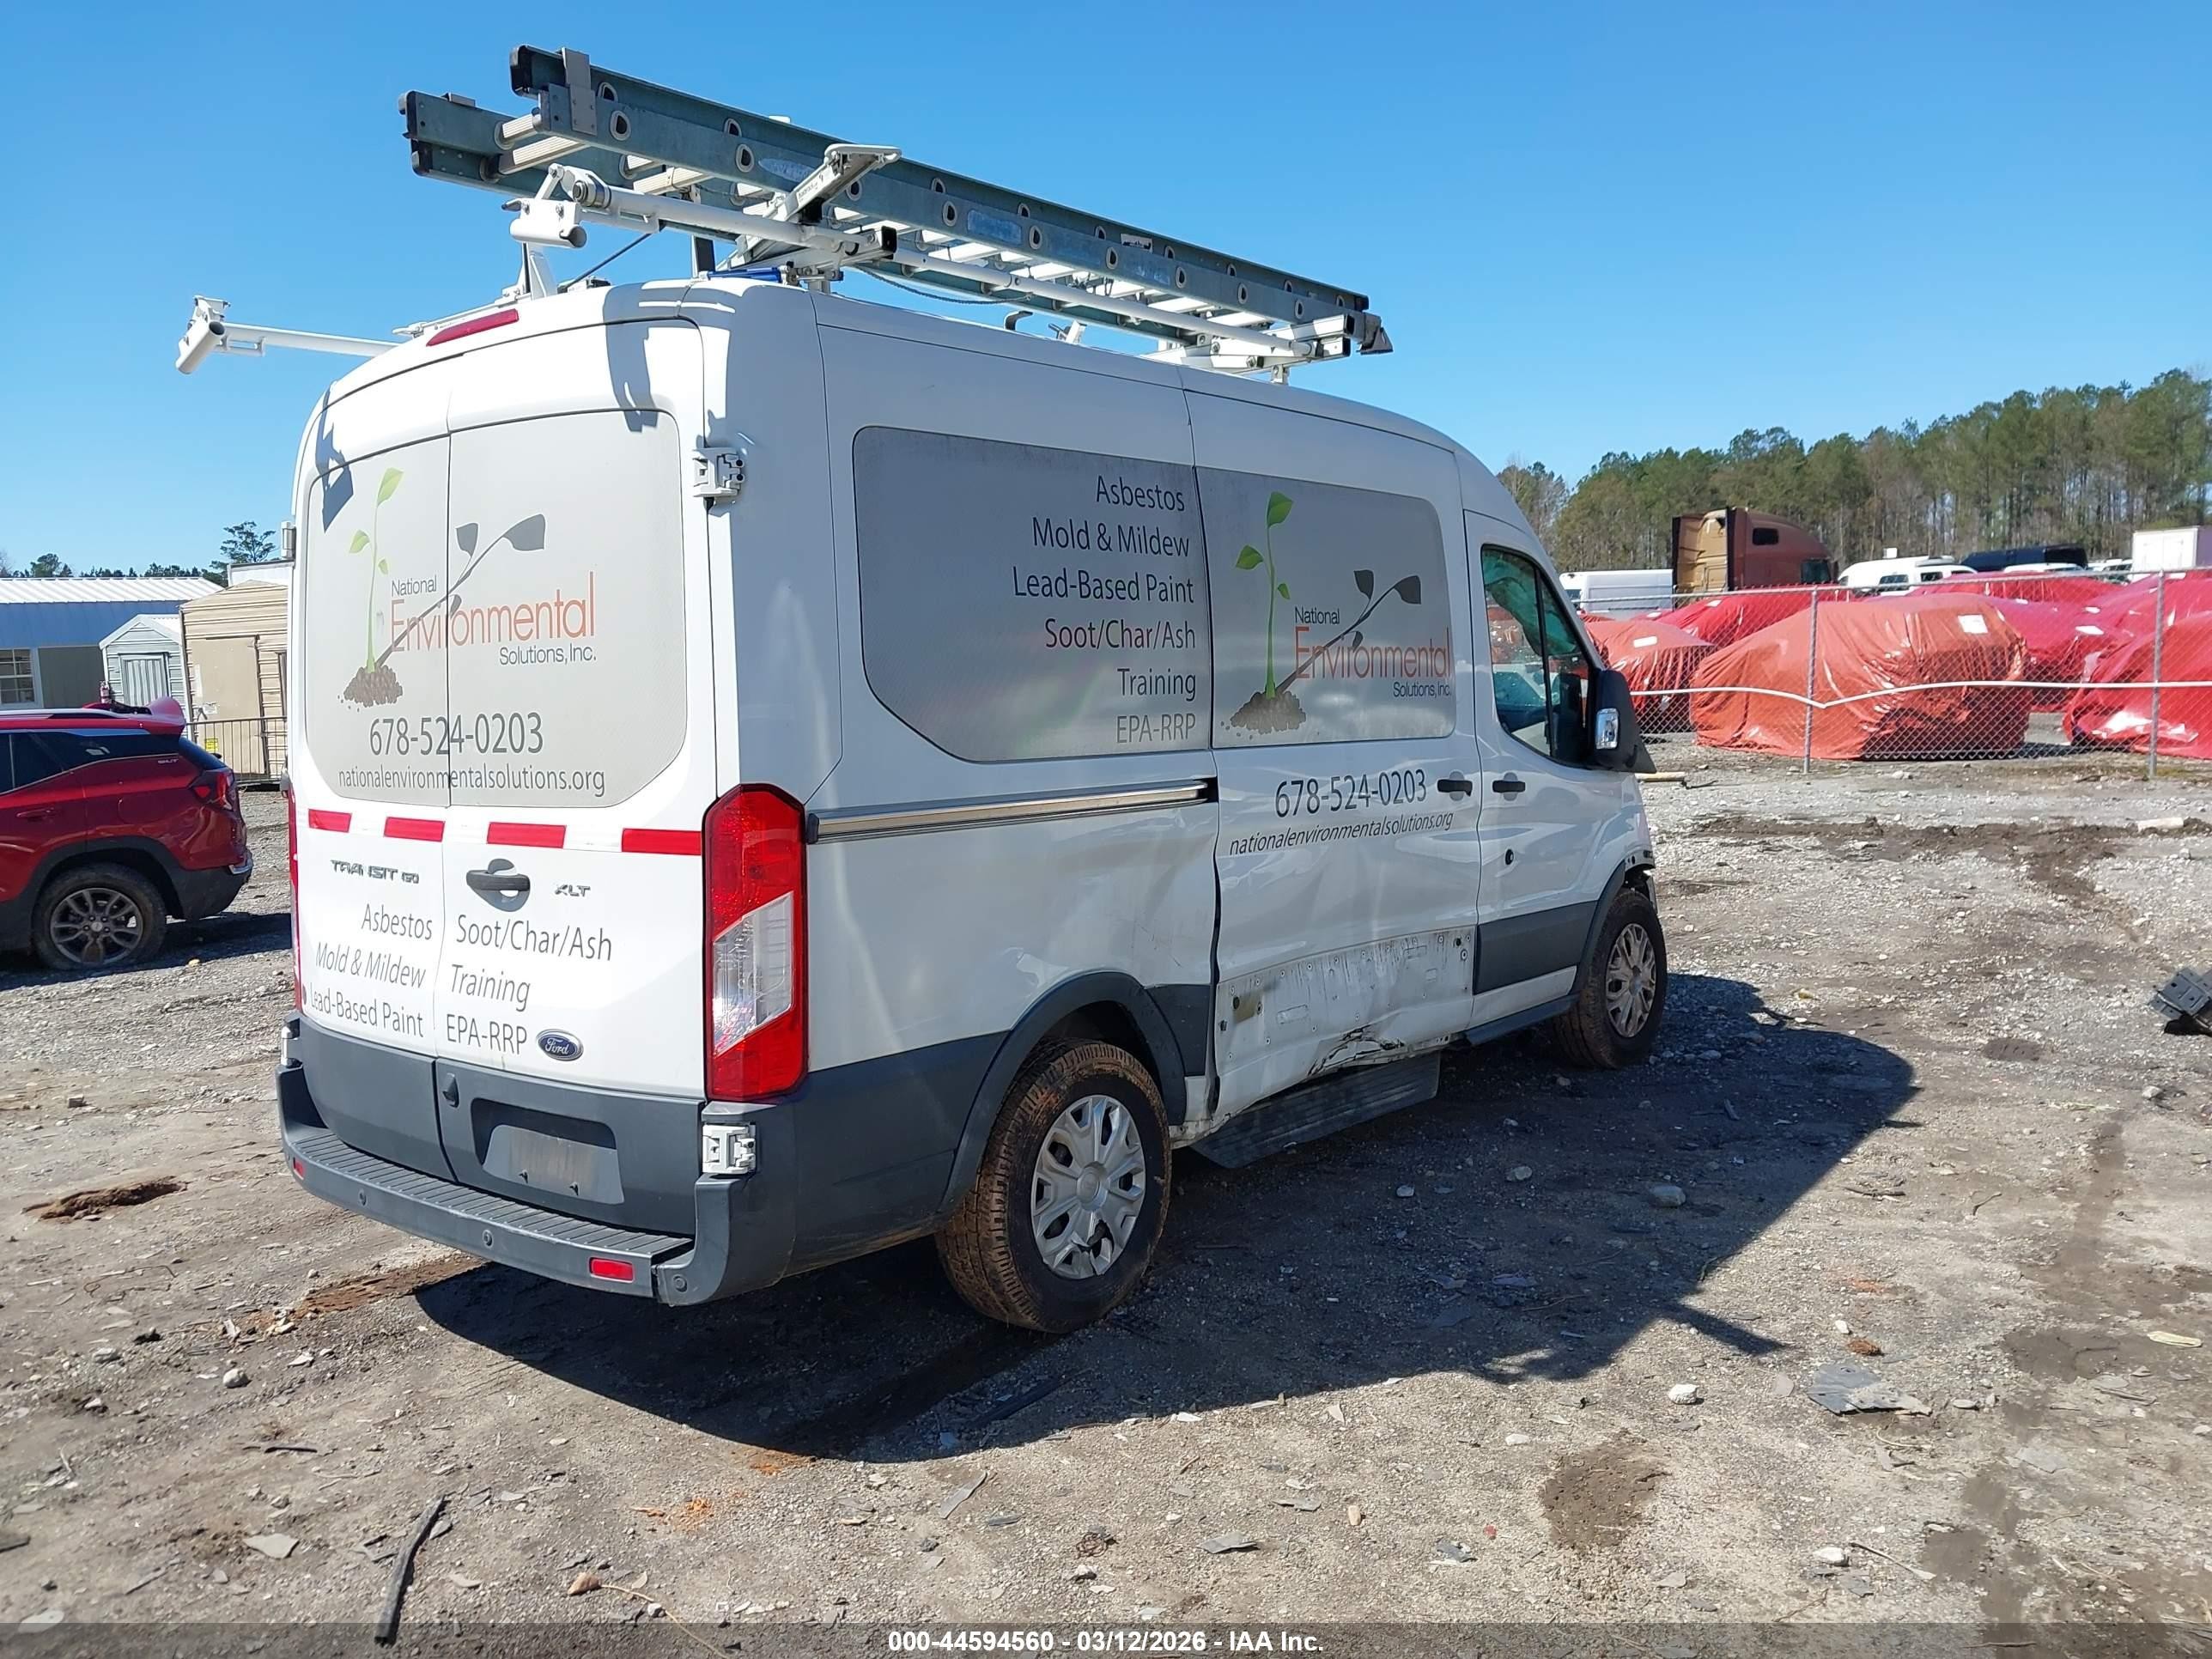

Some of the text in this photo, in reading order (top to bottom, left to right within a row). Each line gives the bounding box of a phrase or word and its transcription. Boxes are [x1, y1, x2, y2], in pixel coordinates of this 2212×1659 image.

[1097, 475, 1185, 512] Asbestos
[1032, 517, 1190, 557] Mold & Mildew
[392, 574, 437, 597] National
[1012, 565, 1194, 603] Lead-Based Paint
[1044, 617, 1196, 650] Soot/Char/Ash
[1294, 606, 1340, 625] National
[1294, 626, 1451, 680] Environmental
[1117, 667, 1197, 702] Training
[369, 711, 544, 757] 678-524-0203
[1116, 713, 1196, 744] EPA-RRP
[338, 762, 605, 798] nationalenvironmentalsolutions.org
[1275, 769, 1427, 818] 678-524-0203
[1229, 811, 1453, 856] nationalenvironmentalsolutions.org
[555, 884, 591, 897] XLT
[361, 903, 433, 942] Asbestos
[456, 914, 612, 962] Soot/Char/Ash
[315, 941, 427, 989] Mold & Mildew
[450, 963, 532, 1012] Training
[310, 981, 424, 1038] Lead-Based Paint
[446, 1013, 528, 1055] EPA-RRP
[544, 1036, 571, 1056] Ford
